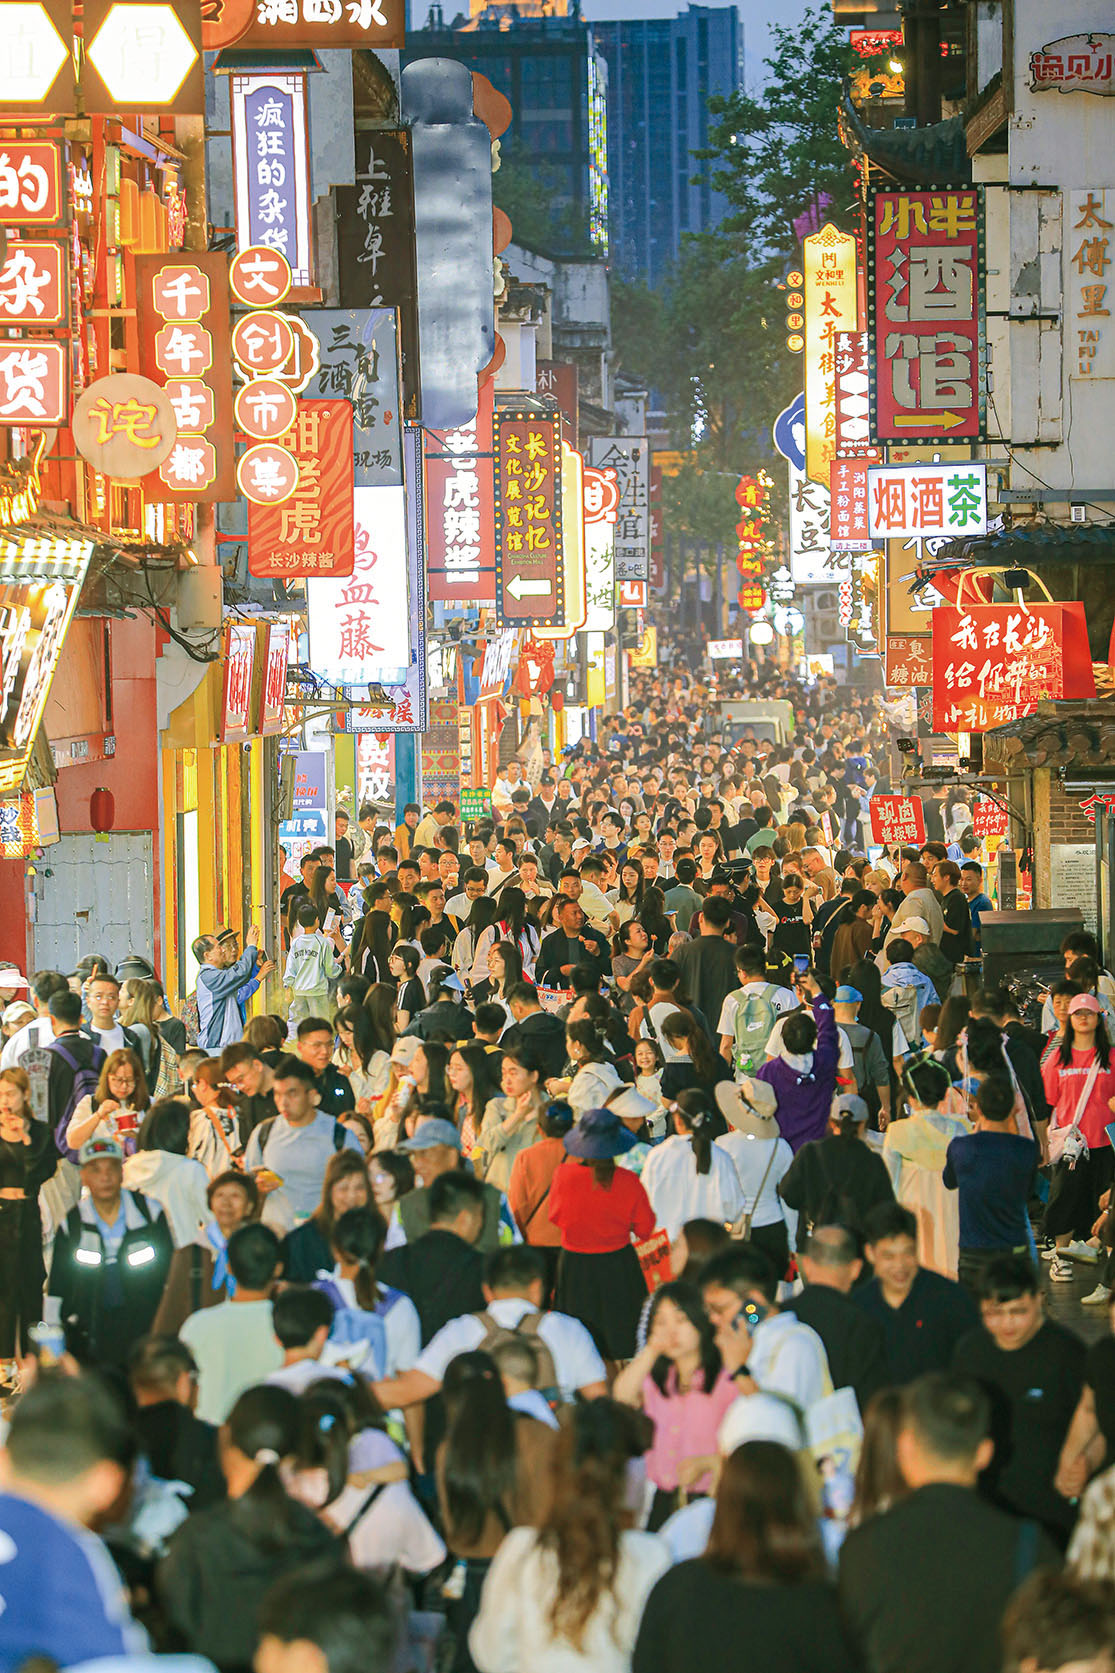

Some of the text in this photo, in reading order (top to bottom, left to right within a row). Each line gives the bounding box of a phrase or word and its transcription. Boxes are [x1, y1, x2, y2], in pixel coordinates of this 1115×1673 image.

[254, 97, 288, 255] 疯狂的杂货
[879, 196, 977, 239] 小半
[815, 270, 845, 281] 文和里
[1072, 192, 1113, 318] 太傅里
[885, 245, 972, 409] 酒馆
[1078, 330, 1099, 342] TAI
[1078, 347, 1096, 358] FU
[160, 274, 206, 483] 千年古都
[1079, 363, 1090, 374] LI
[278, 411, 322, 544] 甜老虎
[442, 416, 480, 583] 老虎辣酱
[505, 433, 524, 552] 文化展览馆
[524, 432, 551, 552] 长沙记忆
[837, 465, 851, 537] 手工粉面馆
[853, 472, 867, 529] 浏阳蒸菜
[873, 474, 982, 529] 烟酒茶
[268, 552, 335, 569] 长沙辣酱
[906, 640, 932, 662] 臭
[950, 613, 1050, 654] 我在长沙
[890, 664, 932, 684] 糖油
[944, 658, 1047, 704] 给你带的
